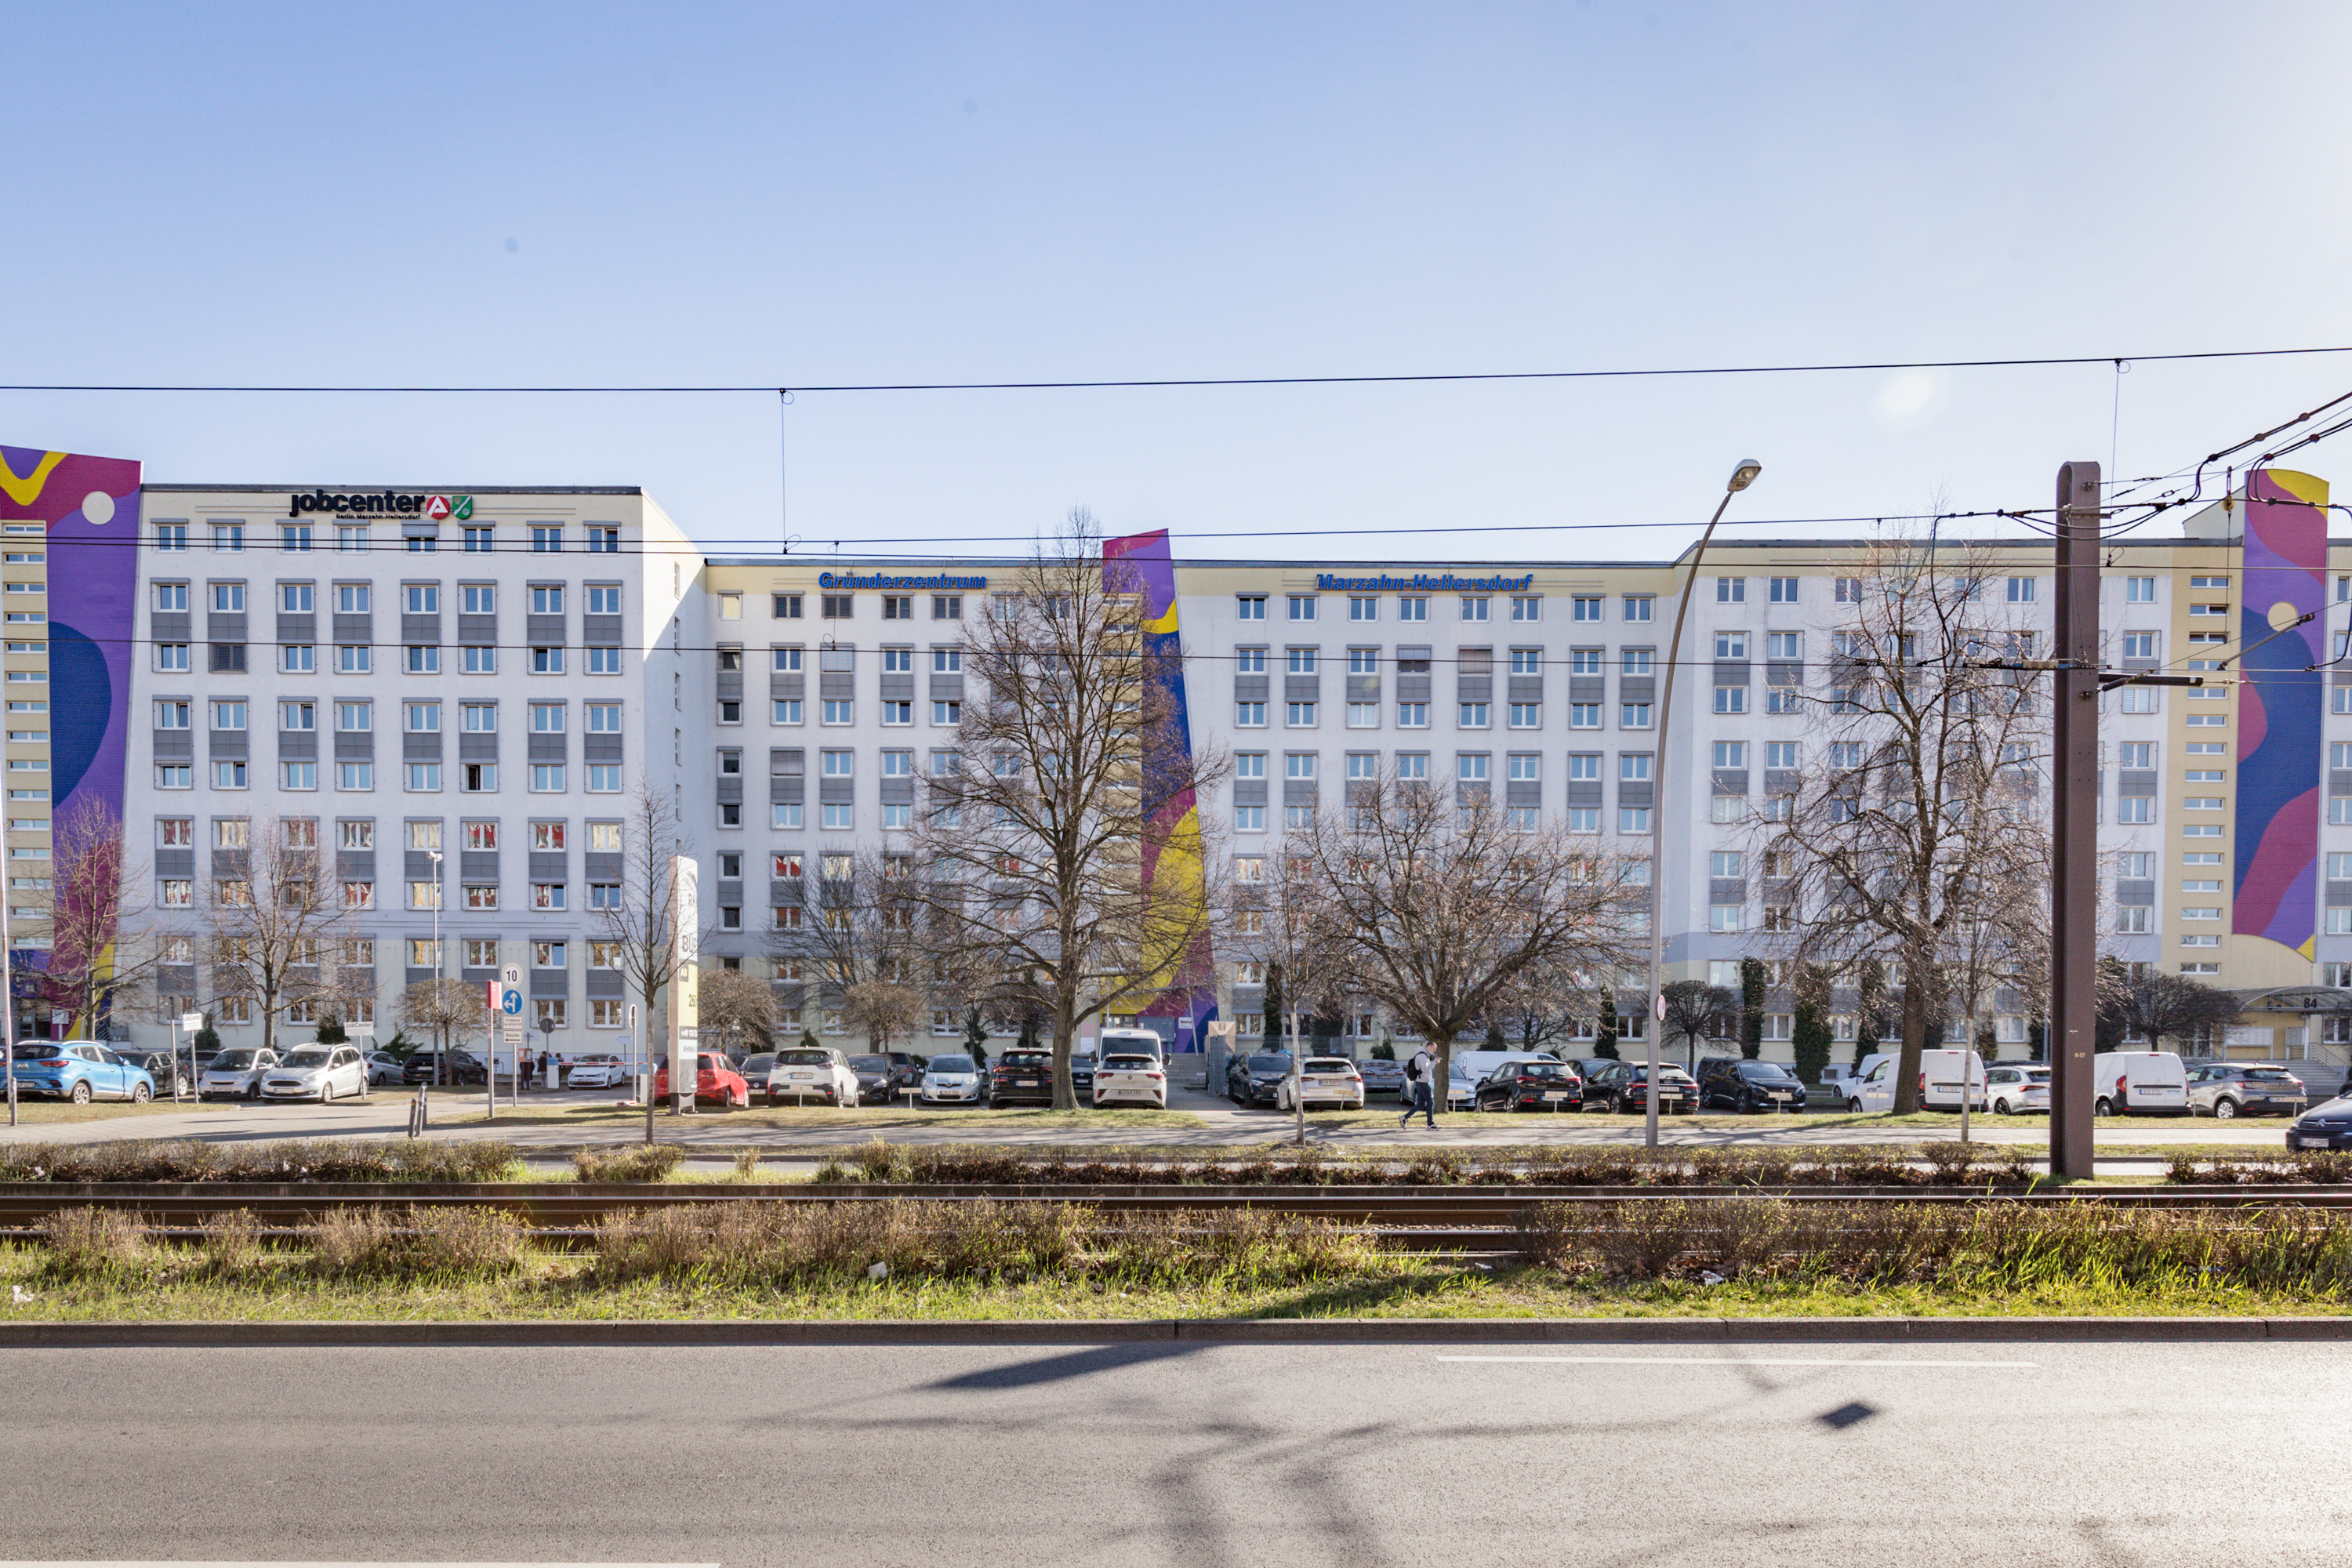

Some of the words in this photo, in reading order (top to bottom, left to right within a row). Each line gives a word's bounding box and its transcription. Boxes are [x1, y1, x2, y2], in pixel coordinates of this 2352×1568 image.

[290, 489, 425, 517] jobcenter
[818, 572, 987, 590] Gründerzentrum
[1315, 573, 1534, 590] Marzahn-Hellersdorf
[506, 970, 517, 982] 10
[681, 968, 688, 977] AB
[2303, 997, 2318, 1008] 84
